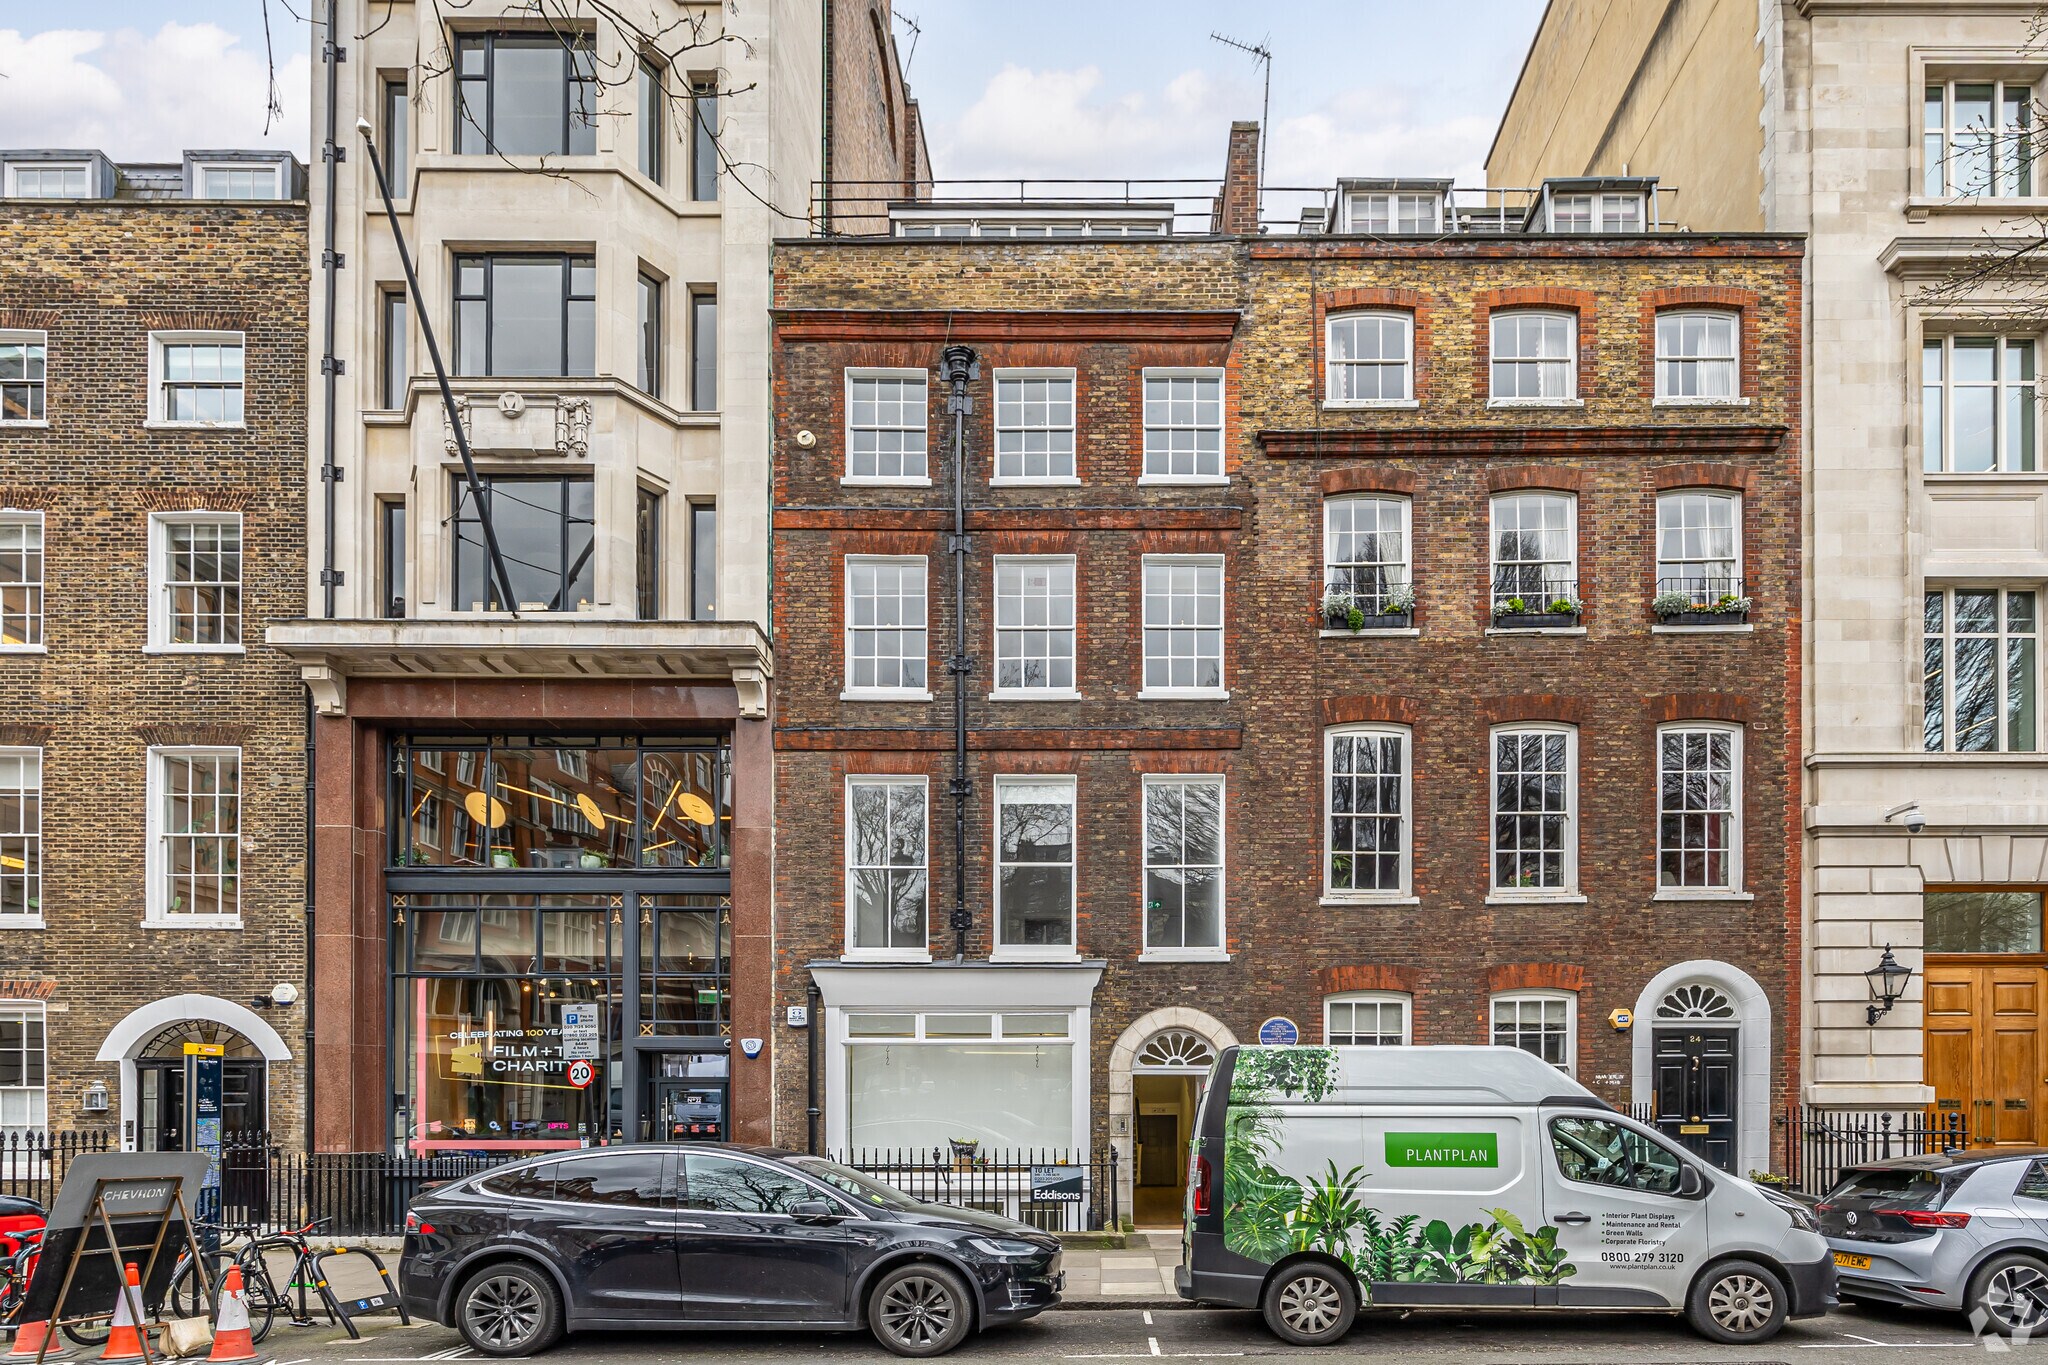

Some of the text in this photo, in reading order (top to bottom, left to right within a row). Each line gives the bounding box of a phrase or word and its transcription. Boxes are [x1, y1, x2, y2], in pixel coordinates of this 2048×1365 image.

[570, 1015, 576, 1023] P
[450, 1029, 524, 1039] CELEBRATING
[572, 1067, 590, 1080] 20
[1406, 1149, 1487, 1161] PLANTPLAN
[104, 1188, 166, 1200] CHEVRON
[1034, 1190, 1080, 1200] Eddisons
[1601, 1252, 1684, 1262] 0800 279 3120
